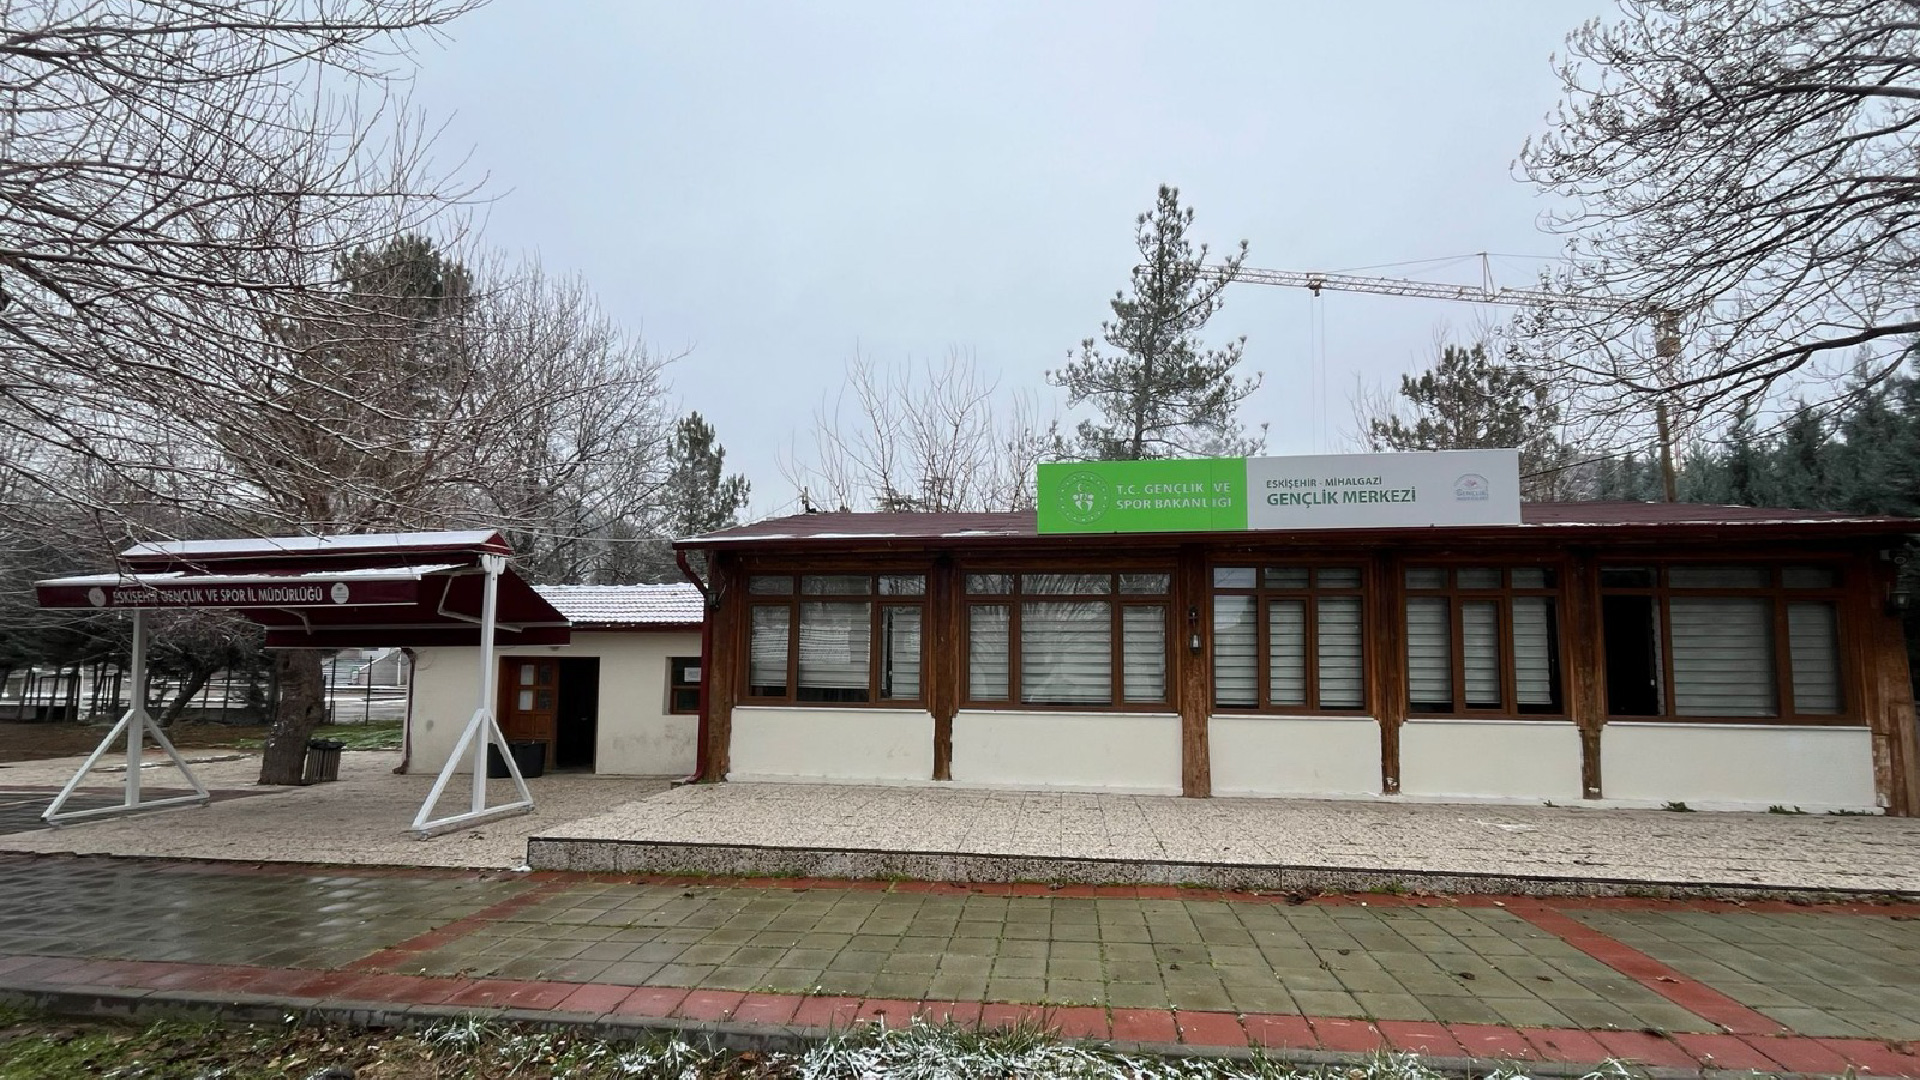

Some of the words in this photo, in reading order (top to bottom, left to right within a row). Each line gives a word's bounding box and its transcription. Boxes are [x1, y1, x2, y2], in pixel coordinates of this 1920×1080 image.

[1213, 482, 1231, 493] VE
[1266, 478, 1316, 489] ESKİŞEHİR
[1325, 477, 1382, 486] MİHALGAZİ
[1267, 489, 1338, 508] GENÇLİK
[1343, 486, 1415, 504] MERKEZİ
[1116, 499, 1151, 510] SPOR
[205, 589, 217, 602] VE
[221, 589, 246, 602] SPOR
[246, 587, 257, 602] İL
[258, 586, 322, 602] MÜDÜRLÜĞÜ
